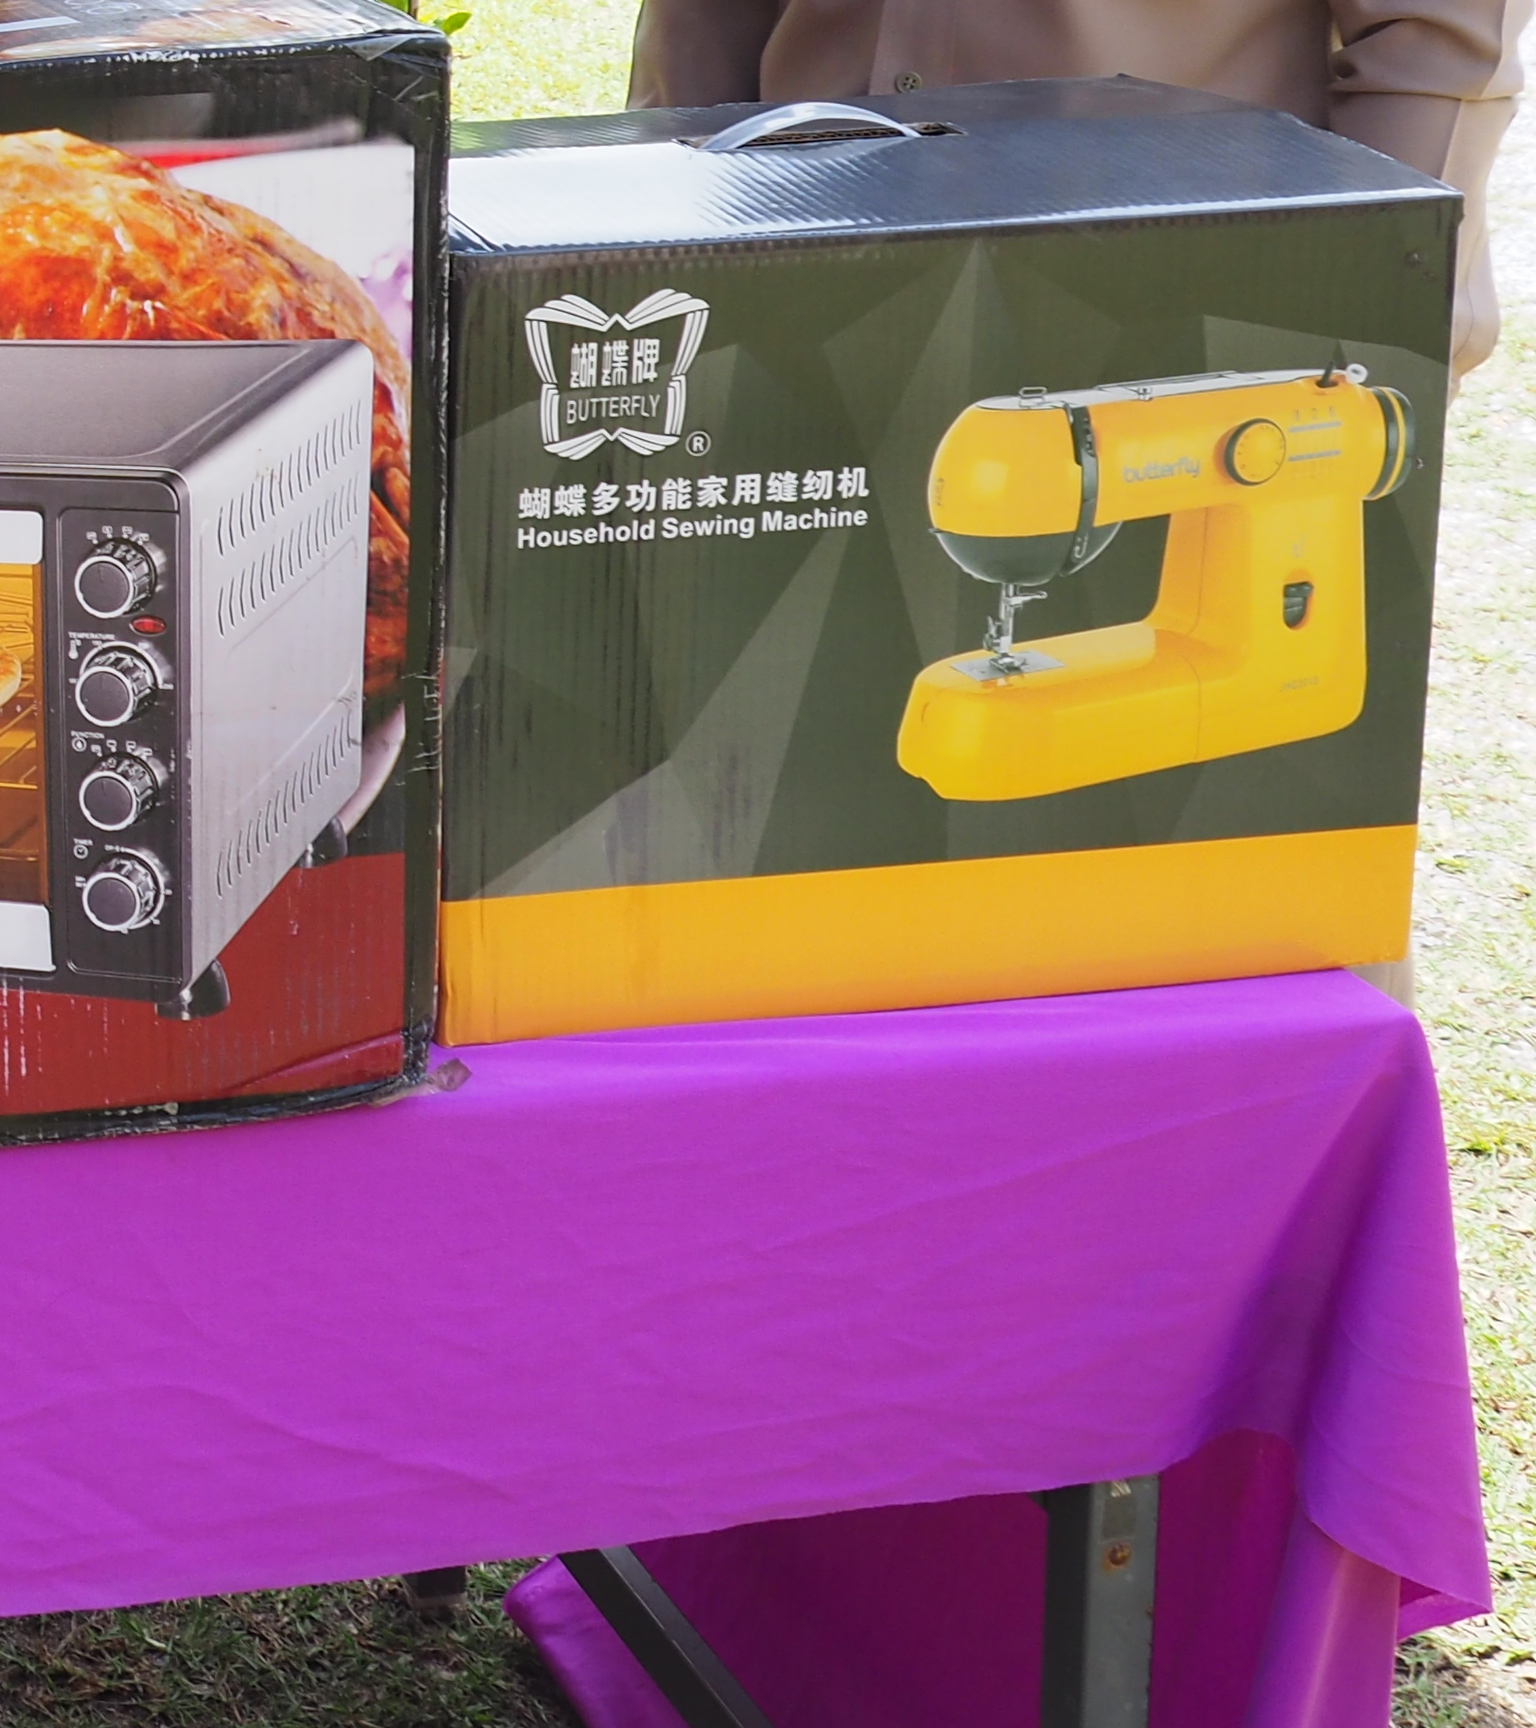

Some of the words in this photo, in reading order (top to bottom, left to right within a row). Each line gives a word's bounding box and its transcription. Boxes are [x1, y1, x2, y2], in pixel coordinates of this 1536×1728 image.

[566, 393, 662, 424] BUTTERFLY
[1122, 456, 1201, 484] butterfly
[518, 466, 869, 521] 蝴蝶多功能家用缝纫机
[517, 518, 655, 549] Household
[661, 515, 756, 545] Sewing
[760, 507, 868, 532] Machine
